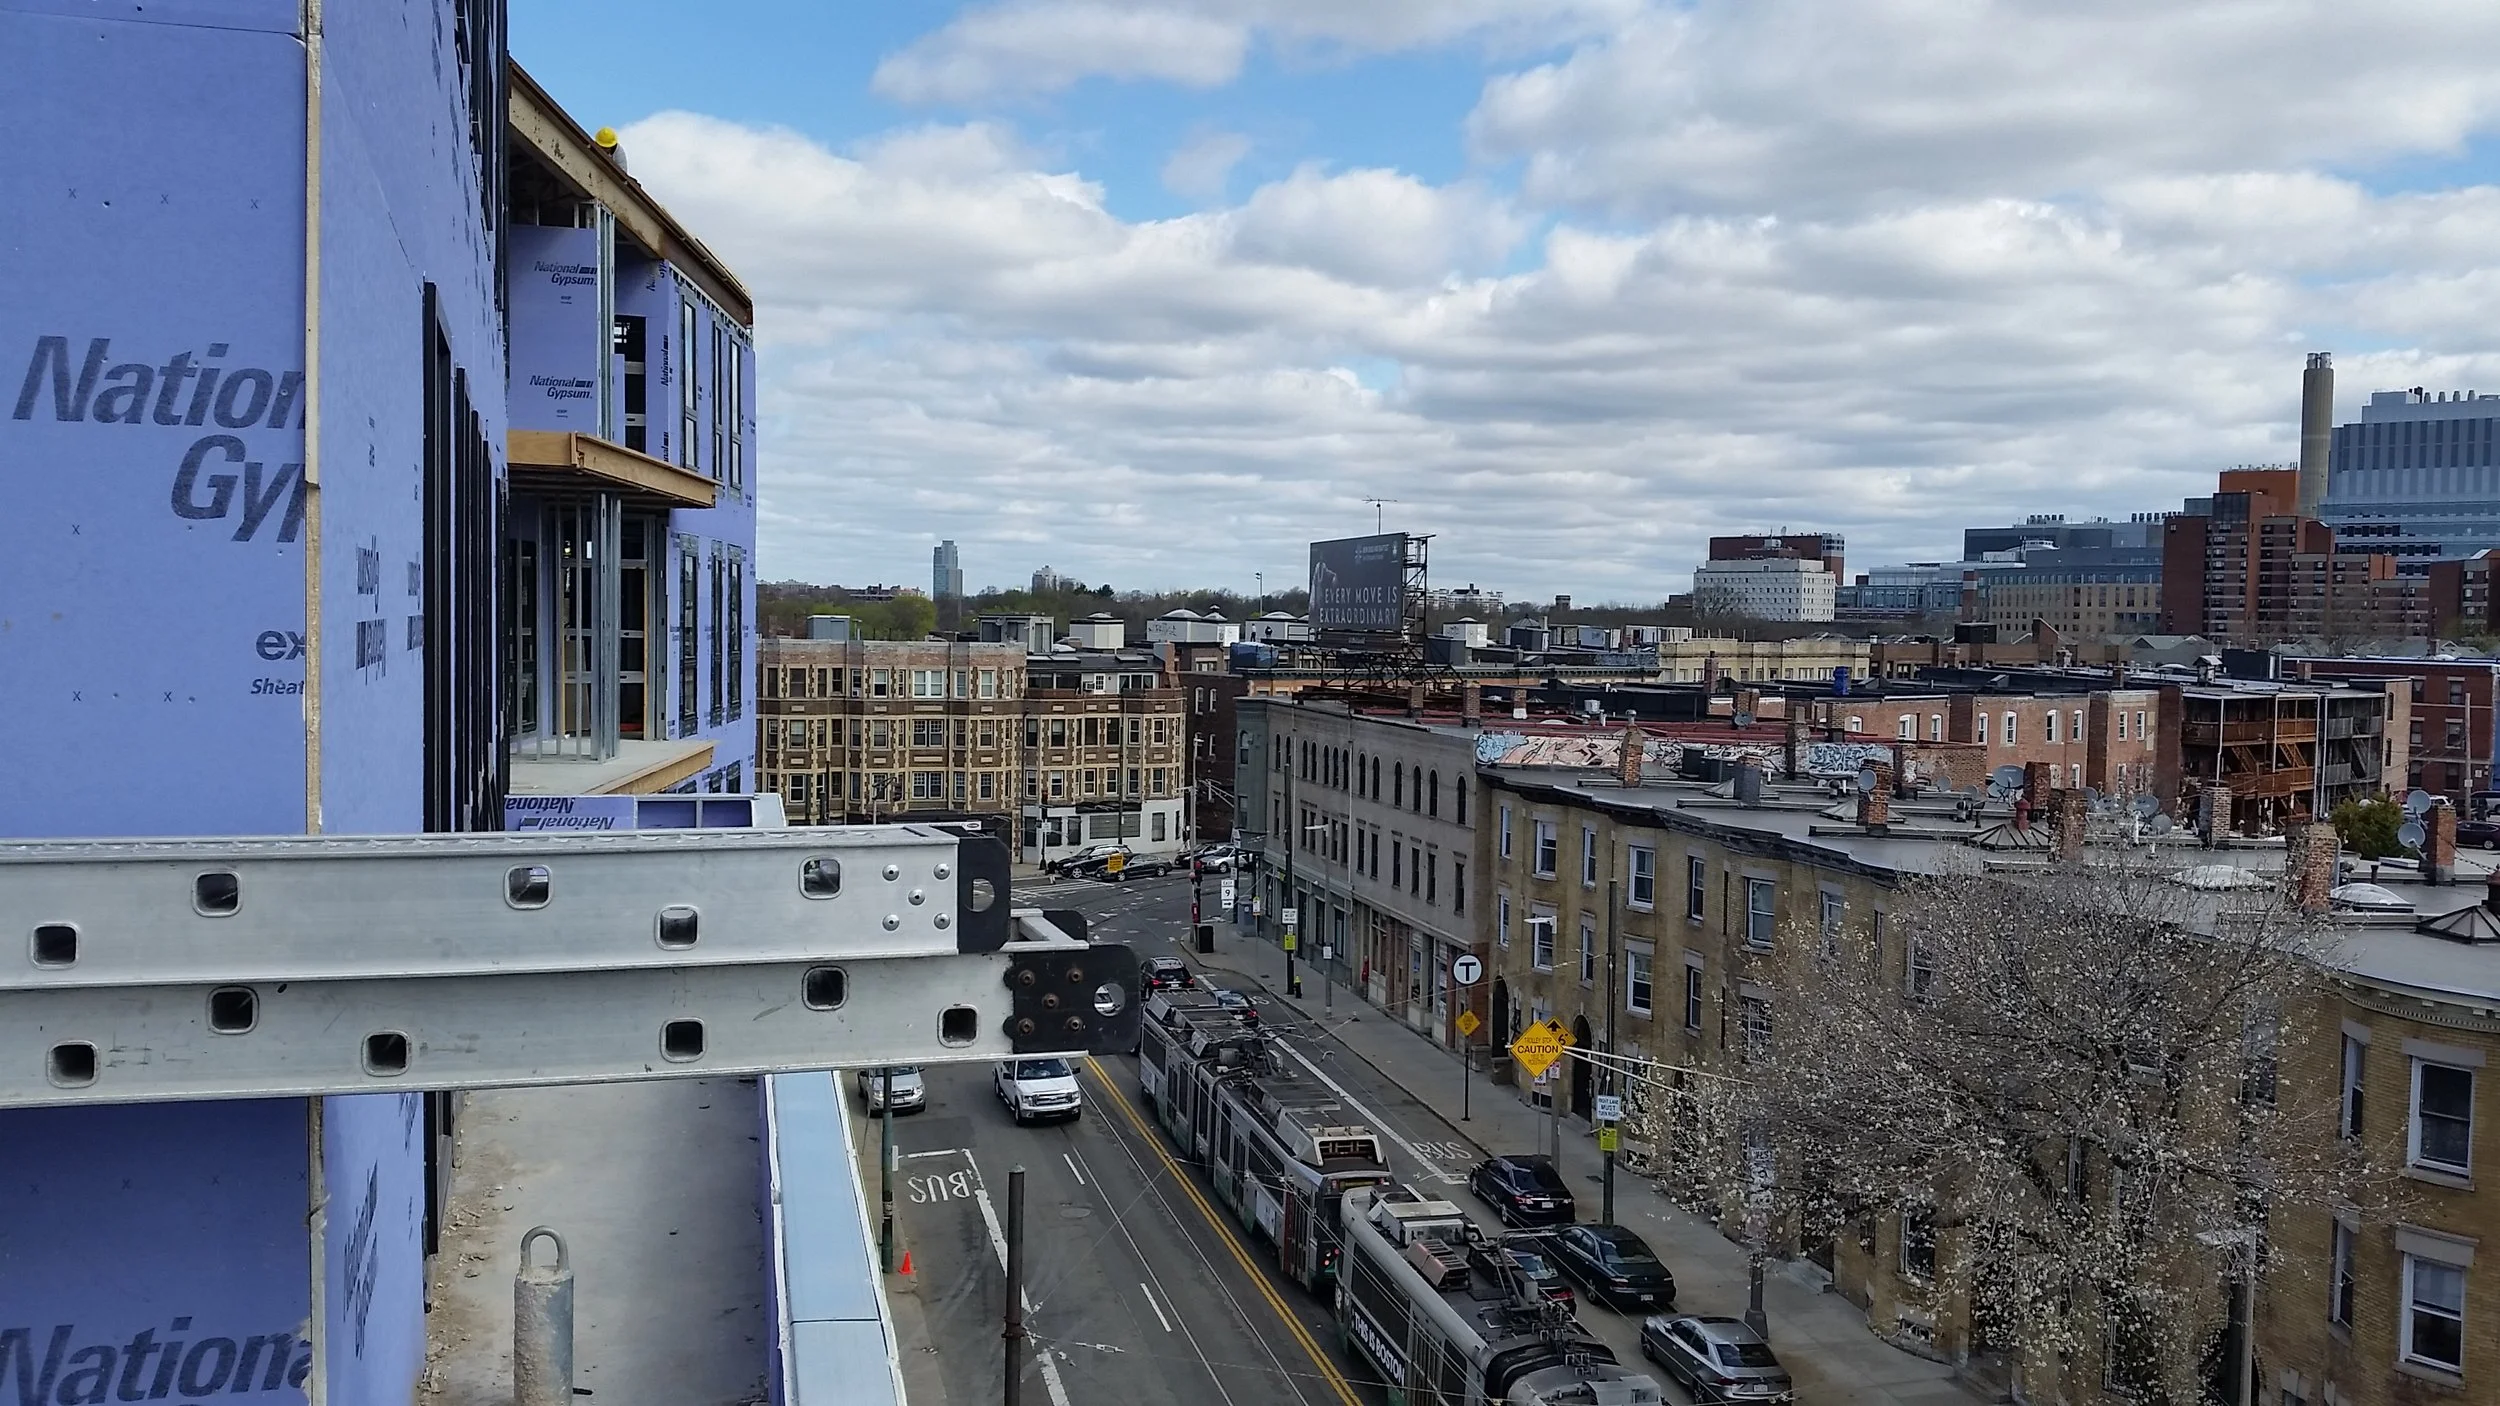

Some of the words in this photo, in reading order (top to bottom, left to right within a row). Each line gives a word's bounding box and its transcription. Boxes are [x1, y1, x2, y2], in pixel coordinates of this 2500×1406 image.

[534, 260, 580, 274] National
[529, 375, 576, 387] National
[1324, 587, 1351, 604] EVERY
[1355, 586, 1382, 605] MOVE
[1387, 586, 1397, 604] IS
[1319, 607, 1398, 625] EXTRAORDINARY
[1458, 961, 1477, 981] T
[1517, 1045, 1559, 1053] CAUTION
[908, 1172, 970, 1203] BUS
[1354, 1311, 1369, 1342] THIS
[1369, 1330, 1376, 1350] IS
[1376, 1337, 1405, 1387] BOSTON
